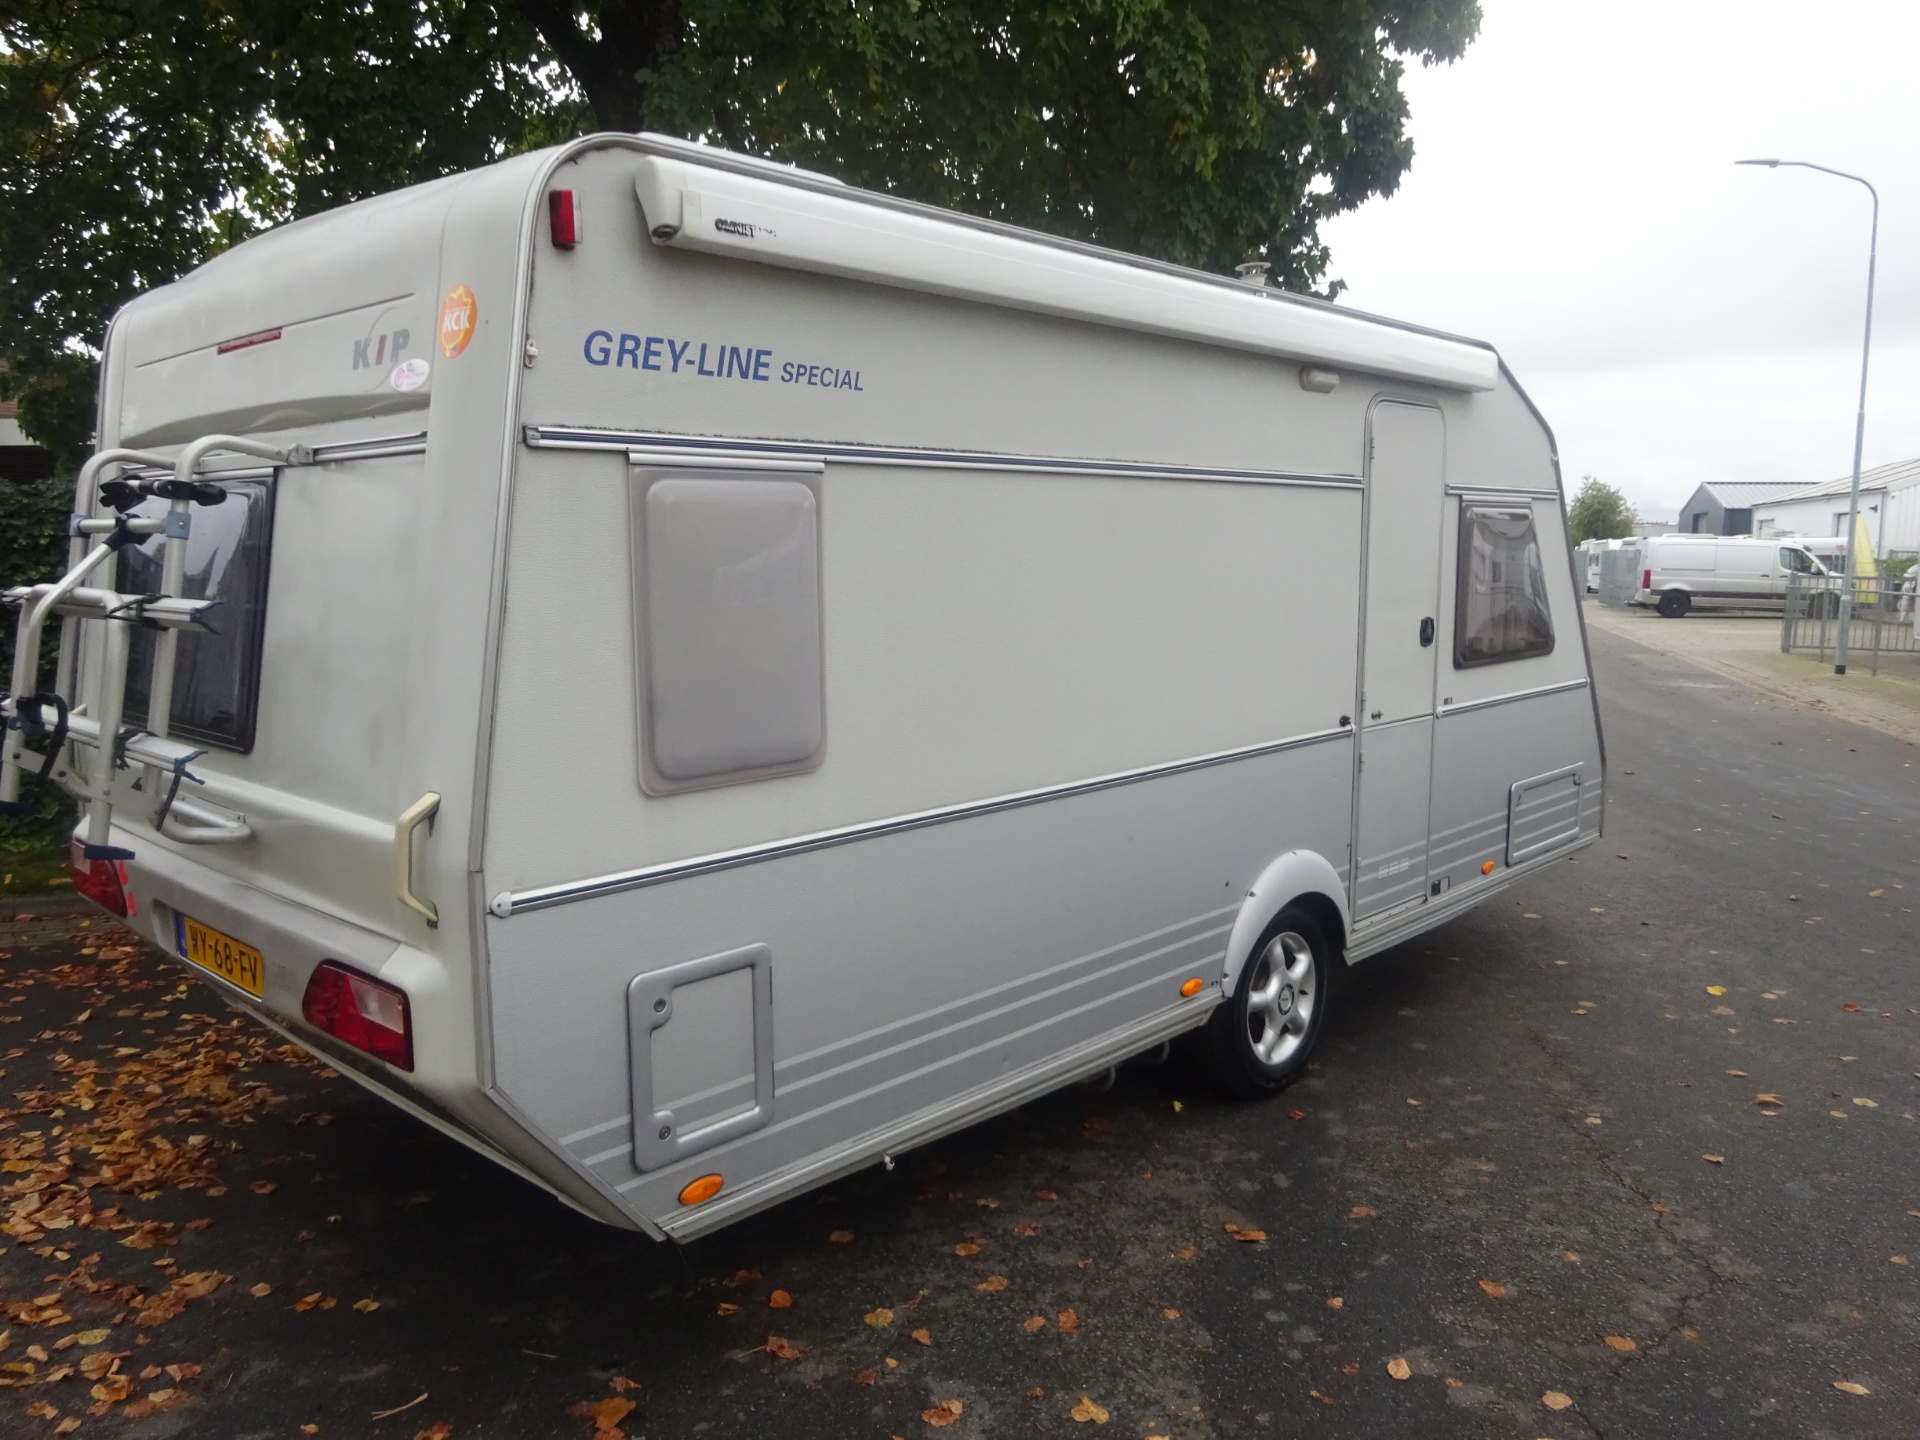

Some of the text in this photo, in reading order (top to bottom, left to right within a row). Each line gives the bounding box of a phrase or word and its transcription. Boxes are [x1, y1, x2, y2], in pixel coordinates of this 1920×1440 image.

[352, 328, 411, 371] KIP
[583, 329, 864, 391] GREY-LINE SPECIAL
